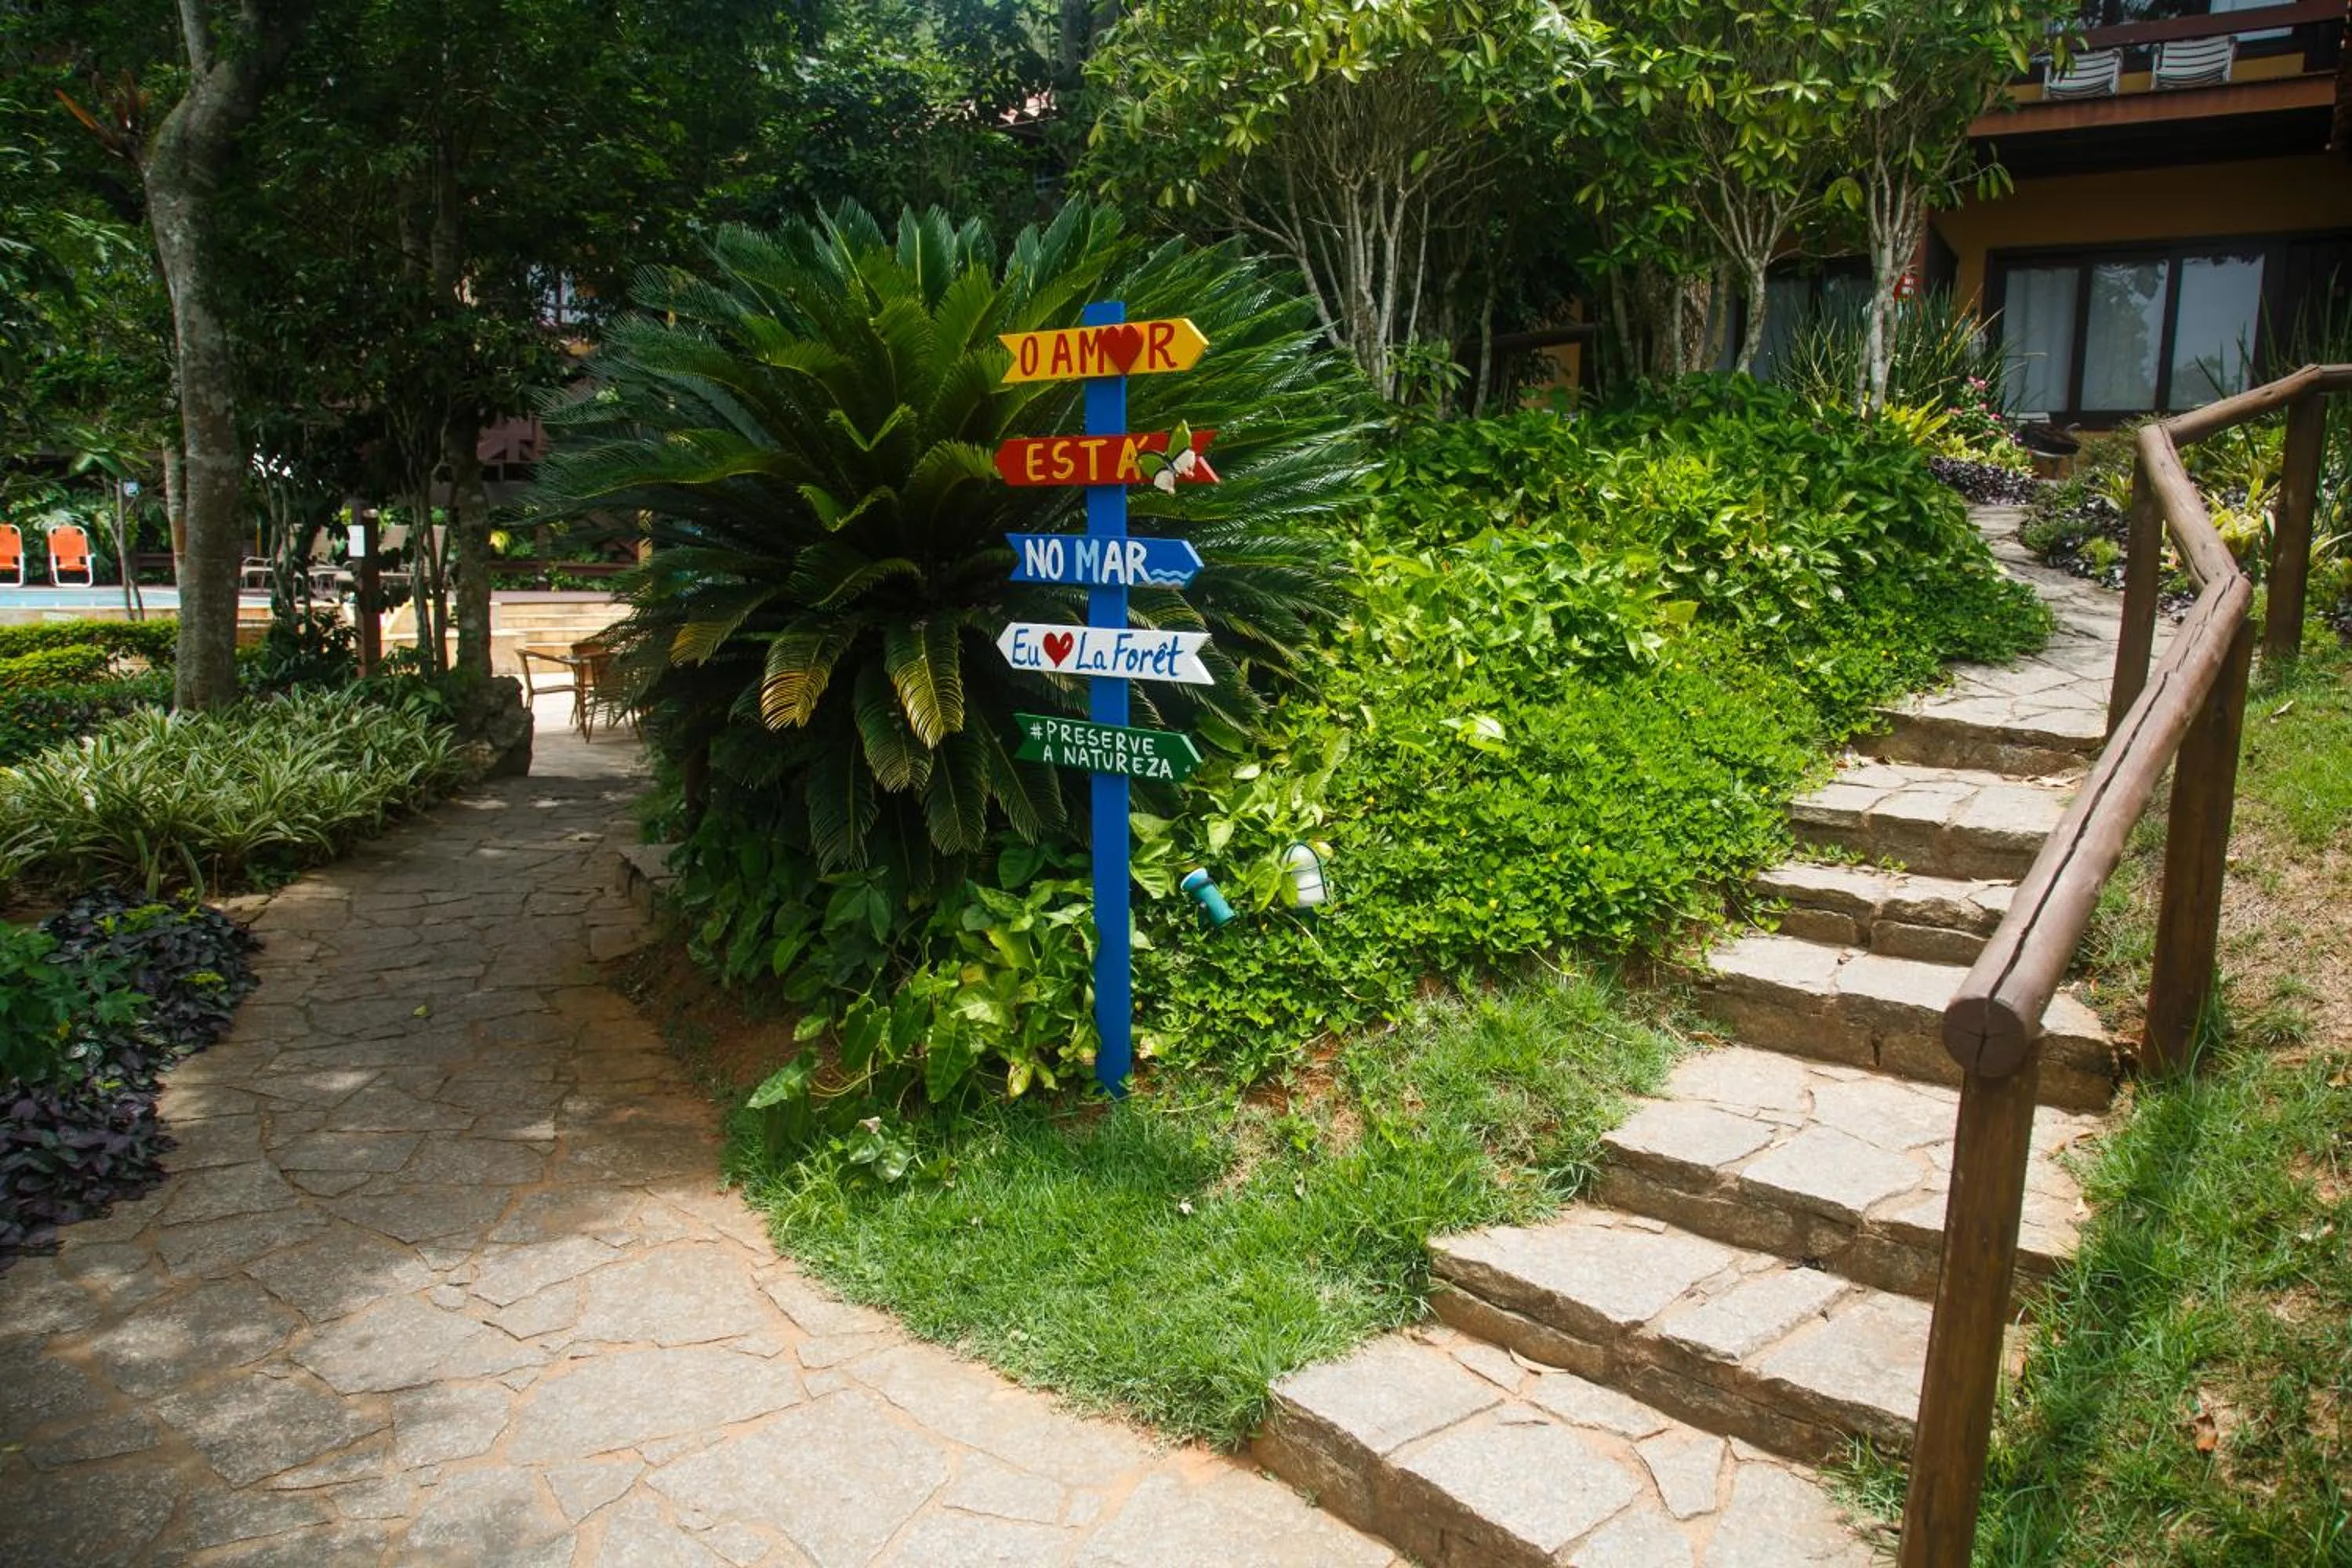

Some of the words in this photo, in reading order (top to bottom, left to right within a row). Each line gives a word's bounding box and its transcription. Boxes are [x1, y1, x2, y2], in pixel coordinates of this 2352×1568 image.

[1020, 336, 1040, 376] O
[1025, 435, 1149, 481] ESTÁ
[1025, 538, 1065, 580] NO
[1075, 539, 1152, 586] MAR
[1012, 629, 1042, 666] Eu
[1112, 633, 1185, 677] Forêt
[1029, 720, 1155, 756] #PRESERVE
[1043, 744, 1054, 763] A
[1063, 745, 1174, 779] NATUREZA
